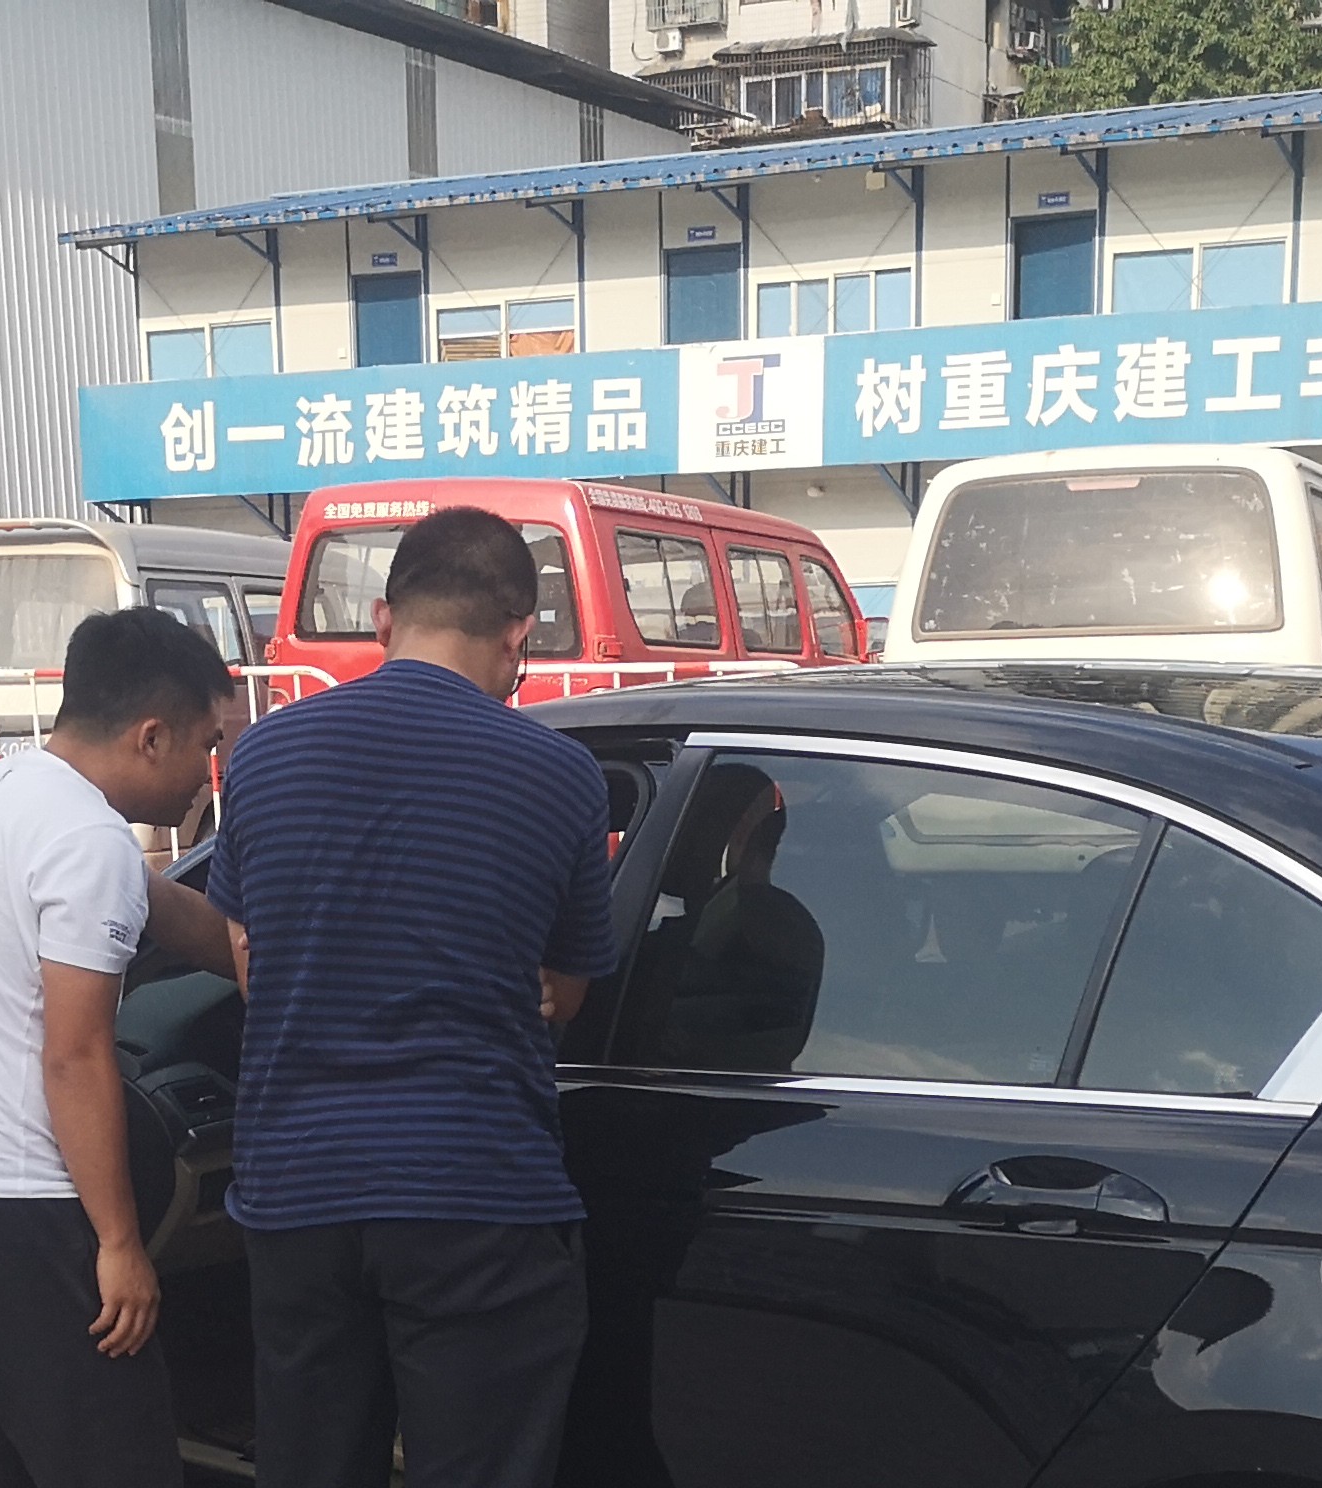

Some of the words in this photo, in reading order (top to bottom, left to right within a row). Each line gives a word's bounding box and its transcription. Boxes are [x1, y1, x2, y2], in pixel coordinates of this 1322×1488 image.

[159, 377, 648, 473] 创一流建筑精品
[718, 421, 784, 435] CCEGC
[715, 438, 786, 457] 重庆建工
